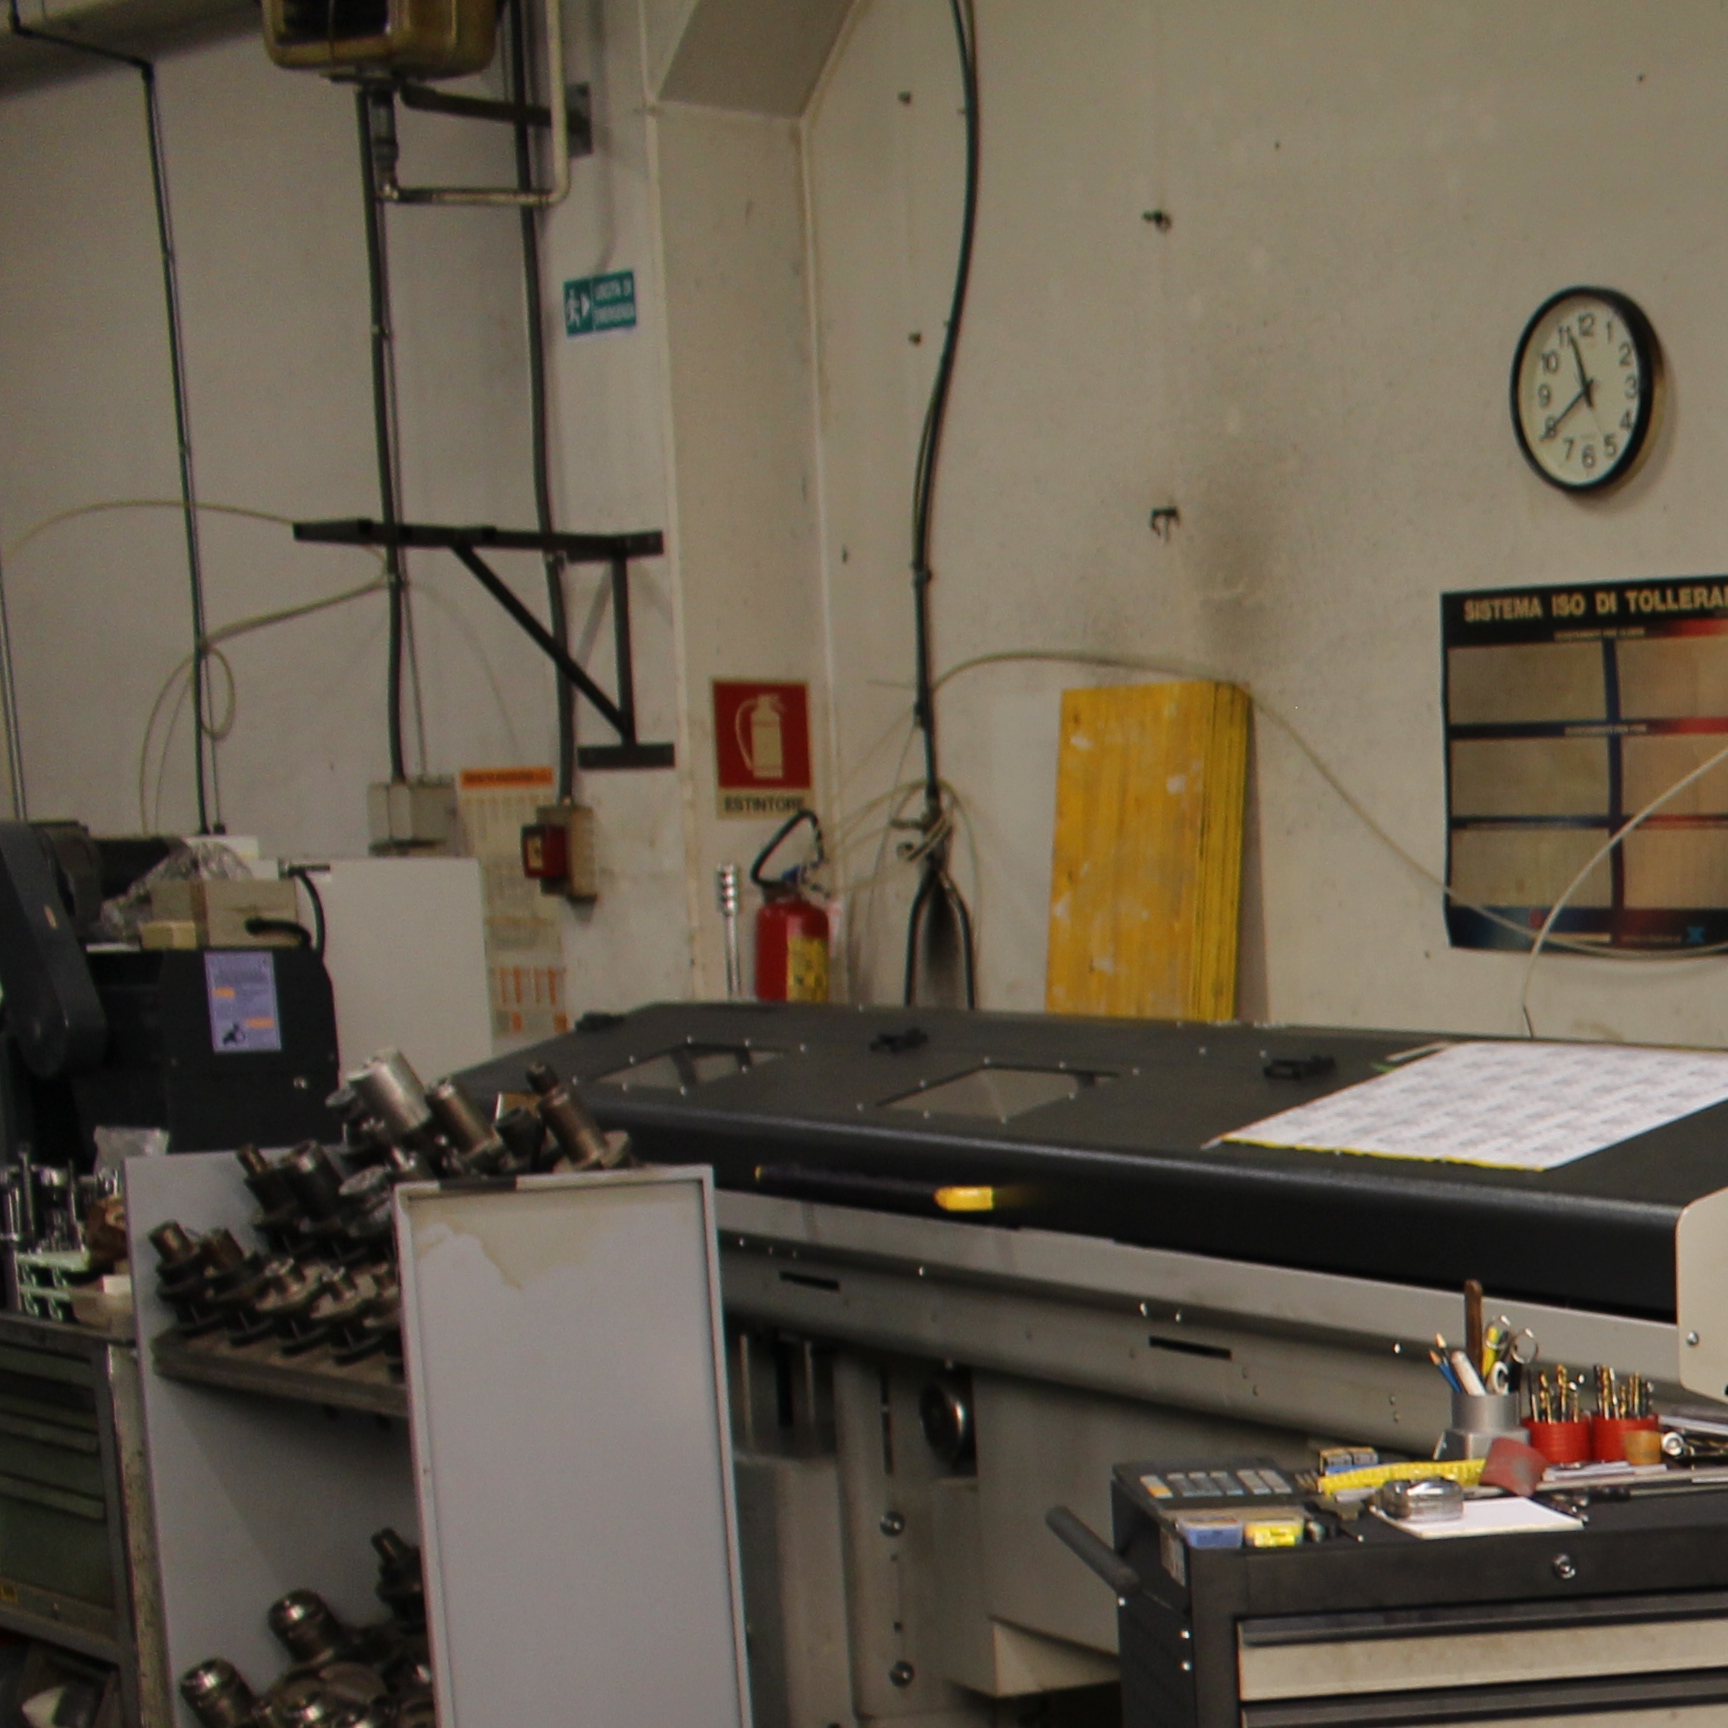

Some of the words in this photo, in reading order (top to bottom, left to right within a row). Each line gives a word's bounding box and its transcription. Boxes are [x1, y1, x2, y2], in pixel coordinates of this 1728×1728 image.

[1578, 312, 1595, 336] 12
[1605, 321, 1613, 343] 1
[1542, 351, 1558, 374] 10
[1618, 343, 1632, 366] 2
[1537, 383, 1550, 407] 9
[1624, 376, 1637, 398] 3
[1620, 411, 1633, 429] 4
[1563, 436, 1574, 460] 7
[1582, 443, 1595, 468] 6
[1604, 433, 1616, 457] 5
[1464, 597, 1543, 622] SISTEMA
[1552, 592, 1586, 617] ISO
[1596, 591, 1617, 615] DI
